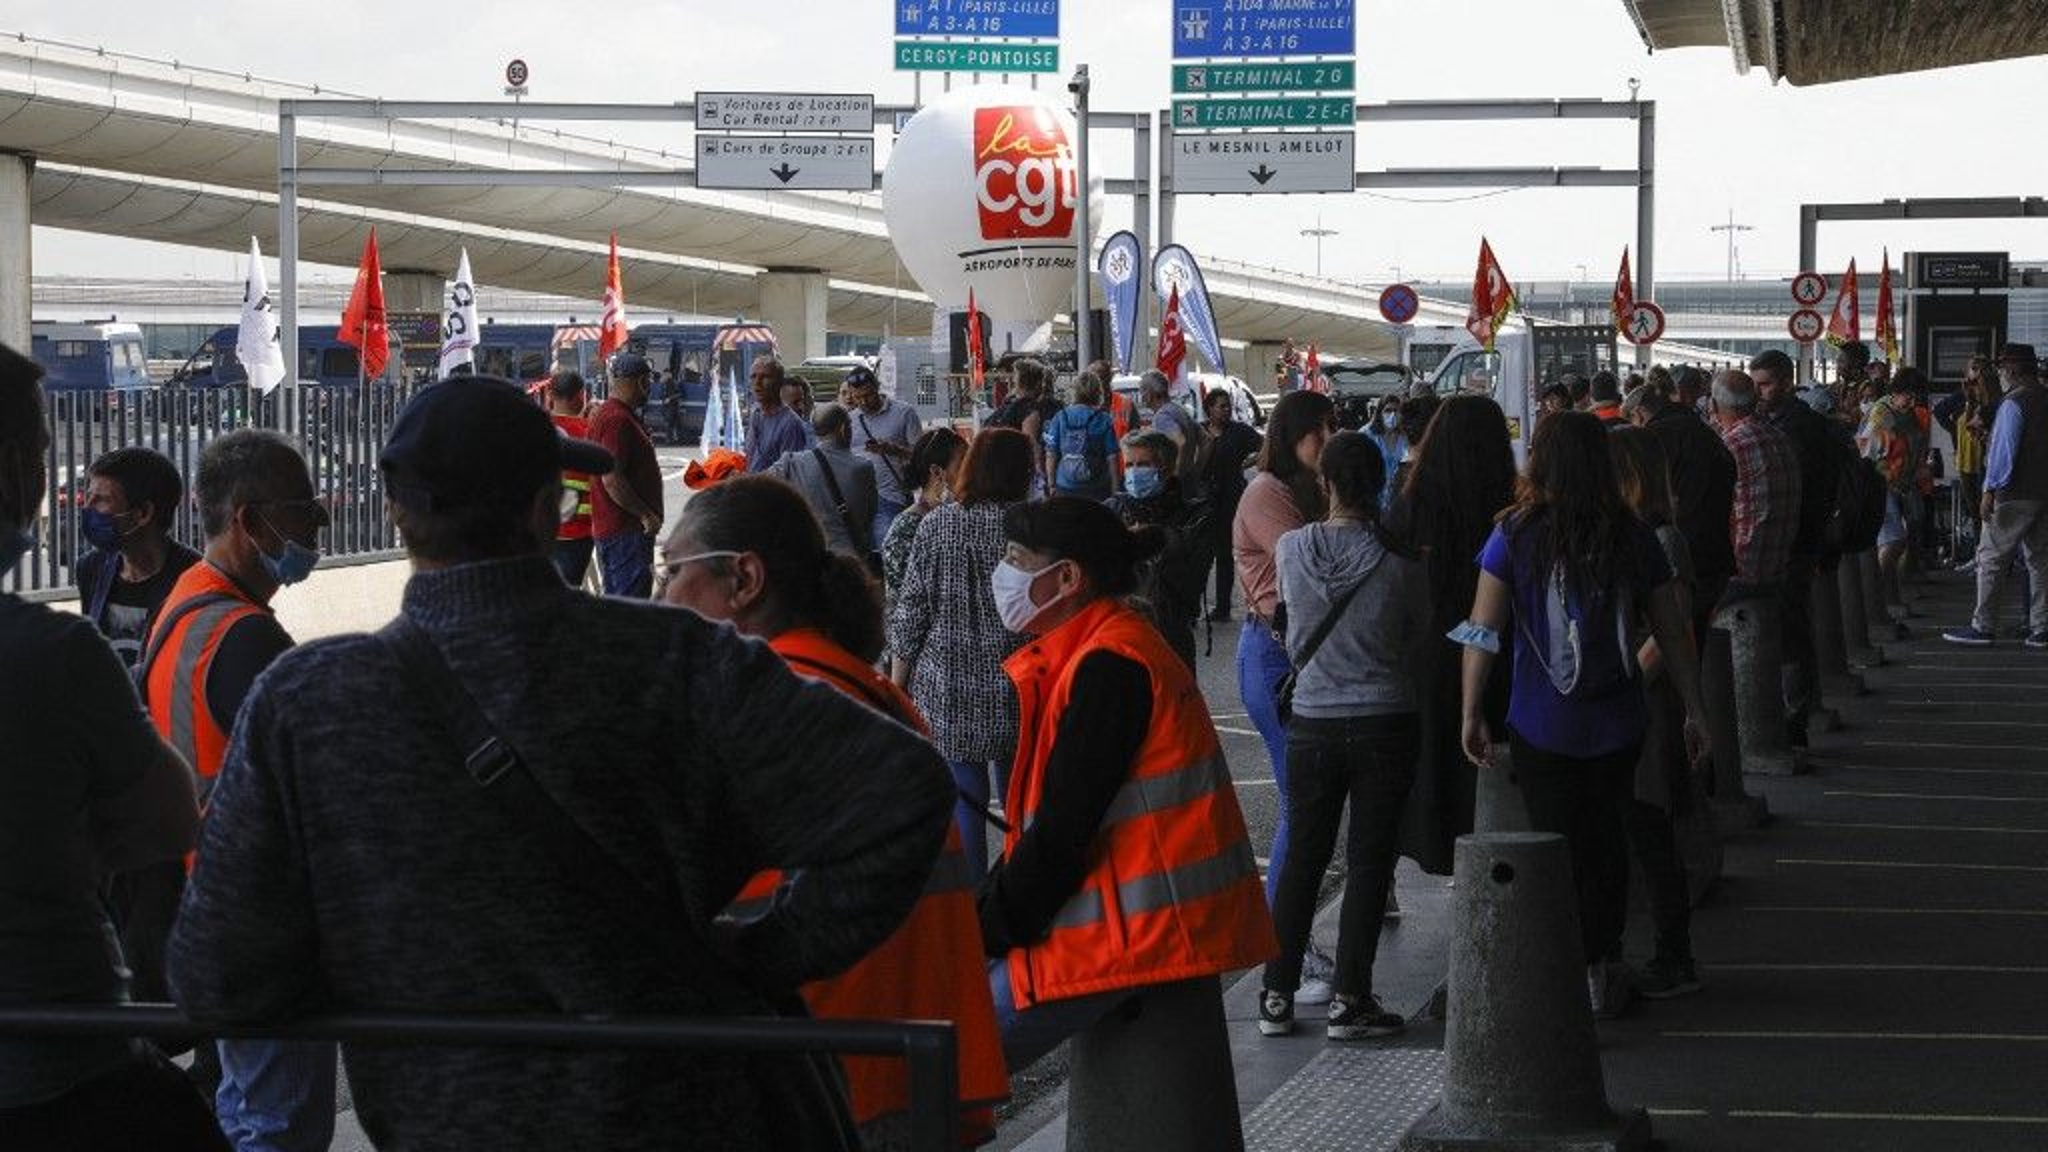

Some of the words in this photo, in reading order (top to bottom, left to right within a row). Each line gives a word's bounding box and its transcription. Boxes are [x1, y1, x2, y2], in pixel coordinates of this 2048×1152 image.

[927, 0, 939, 11] A
[927, 16, 939, 30] A
[1223, 18, 1233, 31] A
[1241, 18, 1247, 30] 1
[1223, 37, 1233, 50] A
[901, 48, 1053, 66] CERGY-PONTOISE
[1213, 71, 1303, 86] TERMINAL
[723, 97, 781, 111] Voitures
[787, 99, 804, 111] de
[809, 99, 869, 111] Location
[723, 113, 747, 125] Car
[753, 113, 799, 125] Rental
[1206, 104, 1296, 121] TERMINAL
[979, 113, 1057, 159] la
[723, 141, 753, 154] Cars
[759, 143, 775, 154] de
[781, 143, 827, 157] Groupe
[1183, 142, 1201, 154] LE
[1209, 141, 1270, 153] MESNIL
[1279, 140, 1343, 153] AMELOT
[977, 143, 1078, 227] cgt
